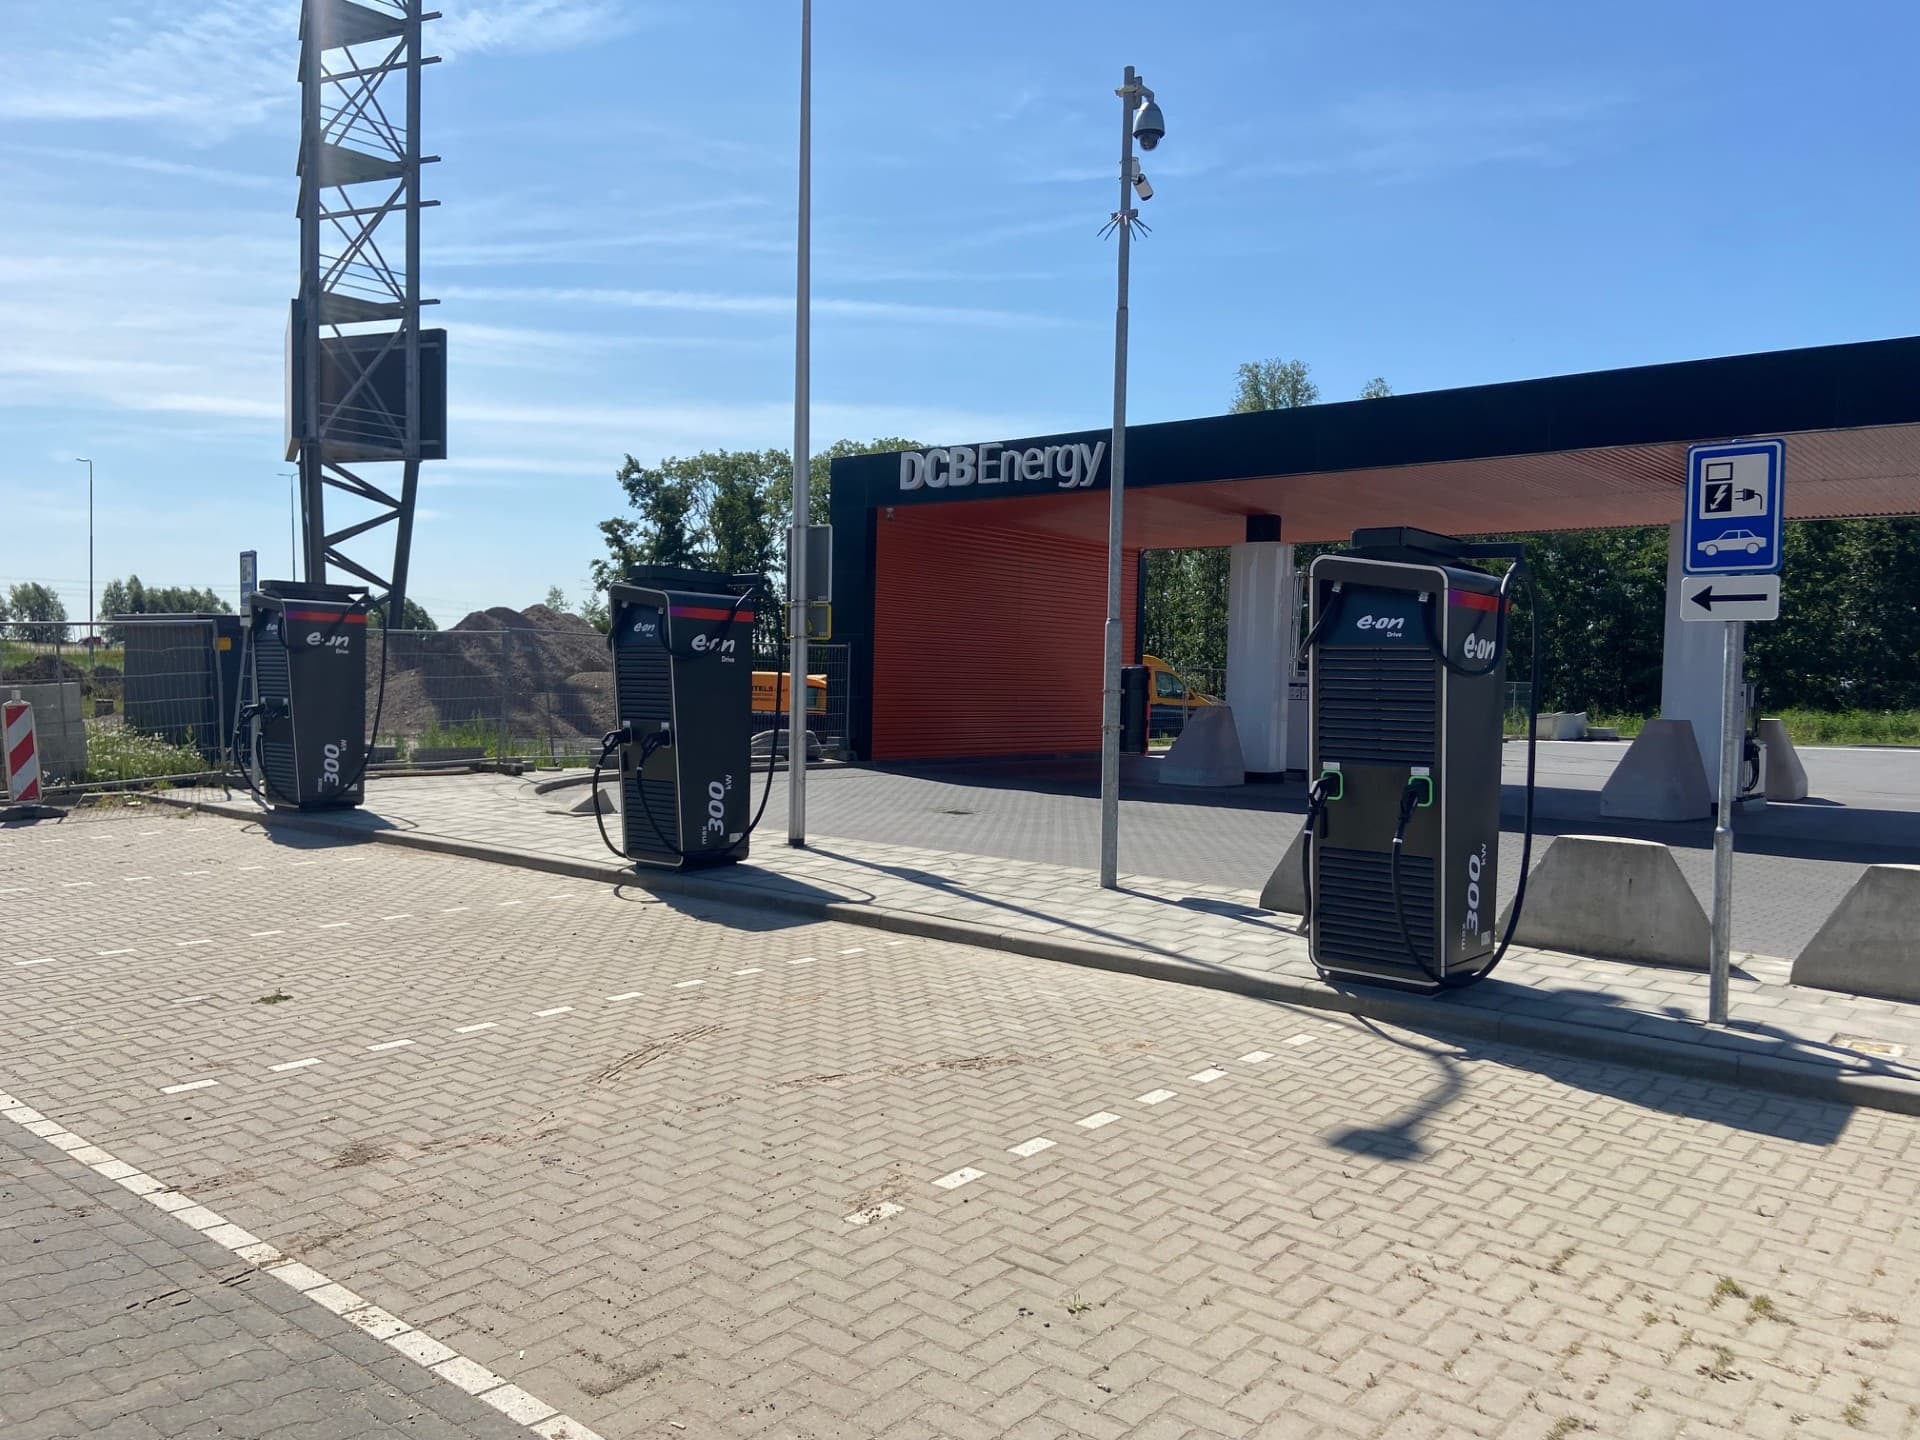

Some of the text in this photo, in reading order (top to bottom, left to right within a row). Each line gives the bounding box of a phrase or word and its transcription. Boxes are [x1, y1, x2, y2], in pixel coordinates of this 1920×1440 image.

[323, 743, 340, 786] 300
[708, 781, 724, 836] 300
[1466, 854, 1481, 936] 300
